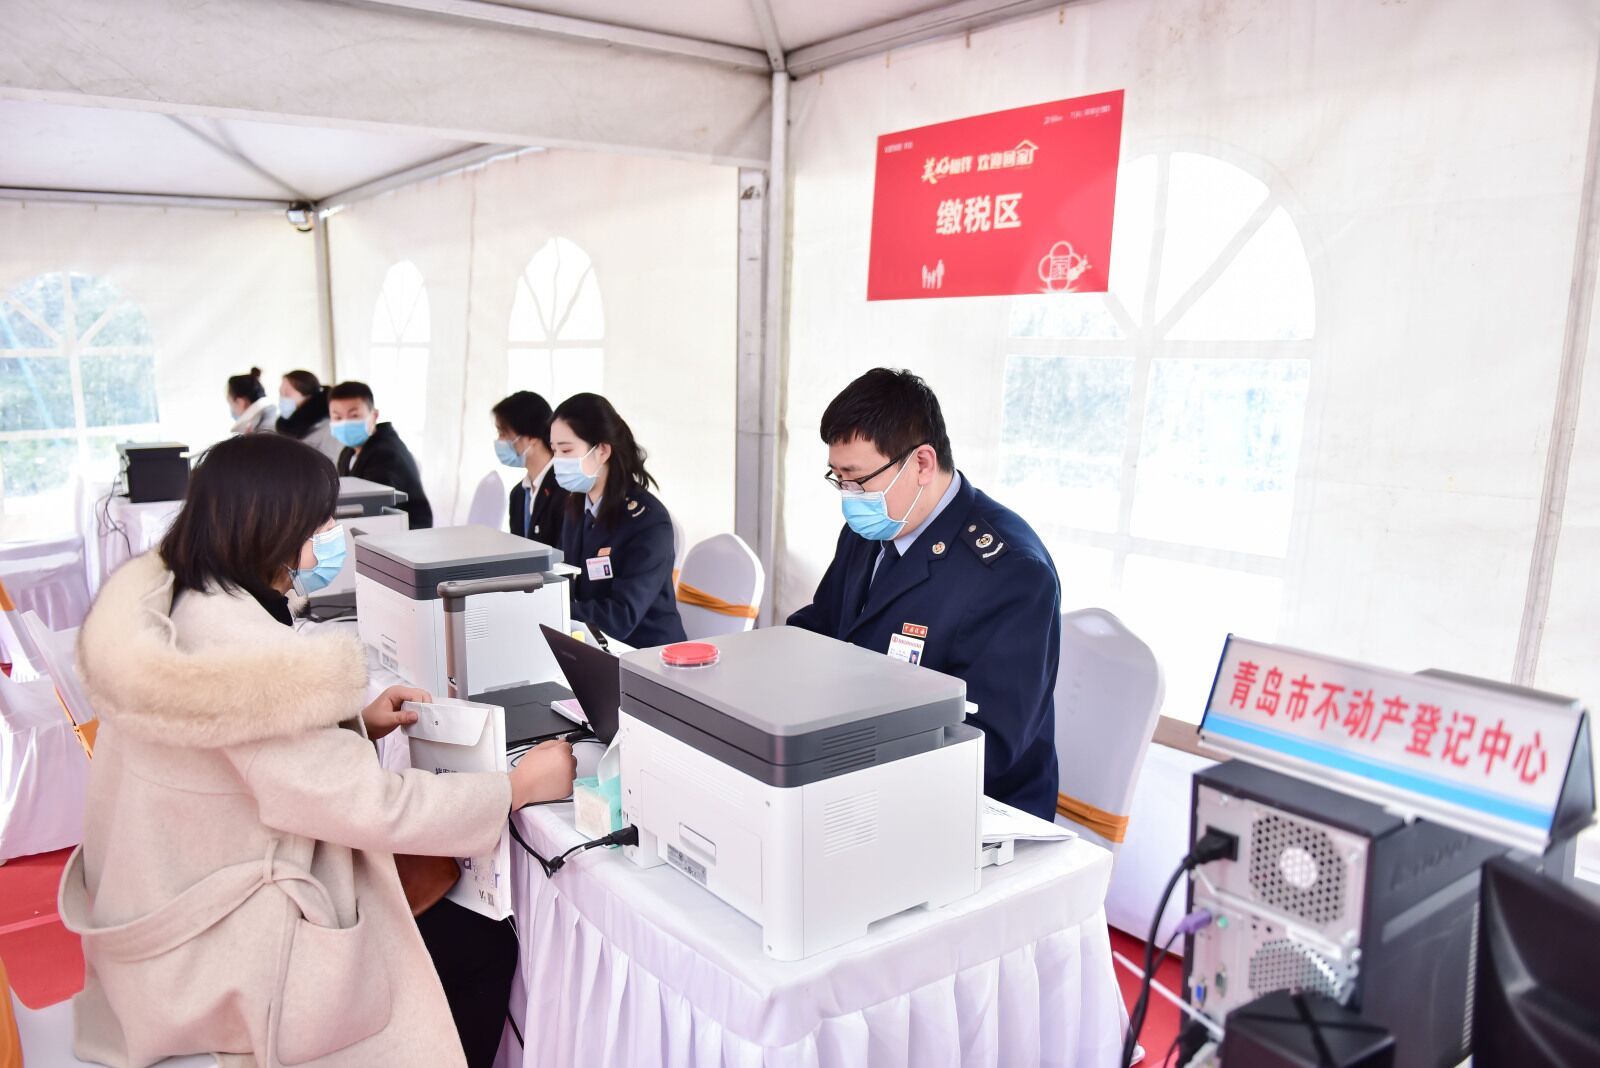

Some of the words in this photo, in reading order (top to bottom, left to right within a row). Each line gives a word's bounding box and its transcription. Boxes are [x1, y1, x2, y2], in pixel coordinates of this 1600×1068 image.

[936, 193, 1022, 235] 缴税区
[1229, 660, 1548, 785] 青岛市不动产登记中心
